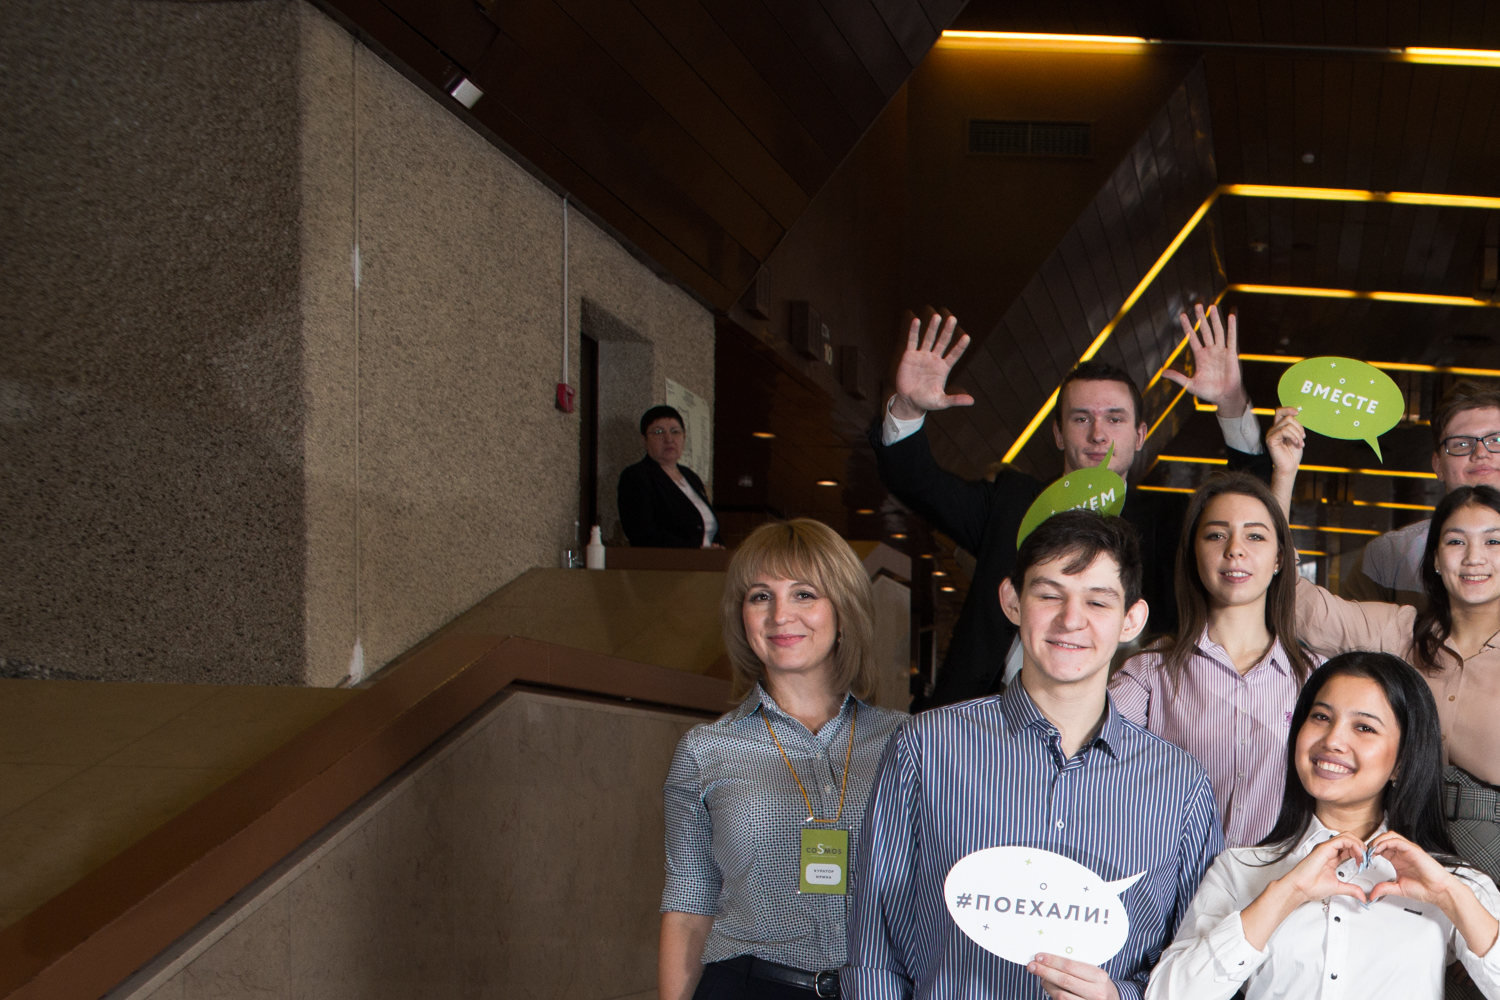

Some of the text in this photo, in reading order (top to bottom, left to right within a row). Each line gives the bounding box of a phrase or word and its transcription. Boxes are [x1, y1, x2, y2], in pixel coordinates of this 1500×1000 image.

[1300, 379, 1379, 415] ВМЕСТЕ
[805, 843, 843, 855] COSMOS
[956, 892, 1110, 925] #ПОЕХАЛИ!
